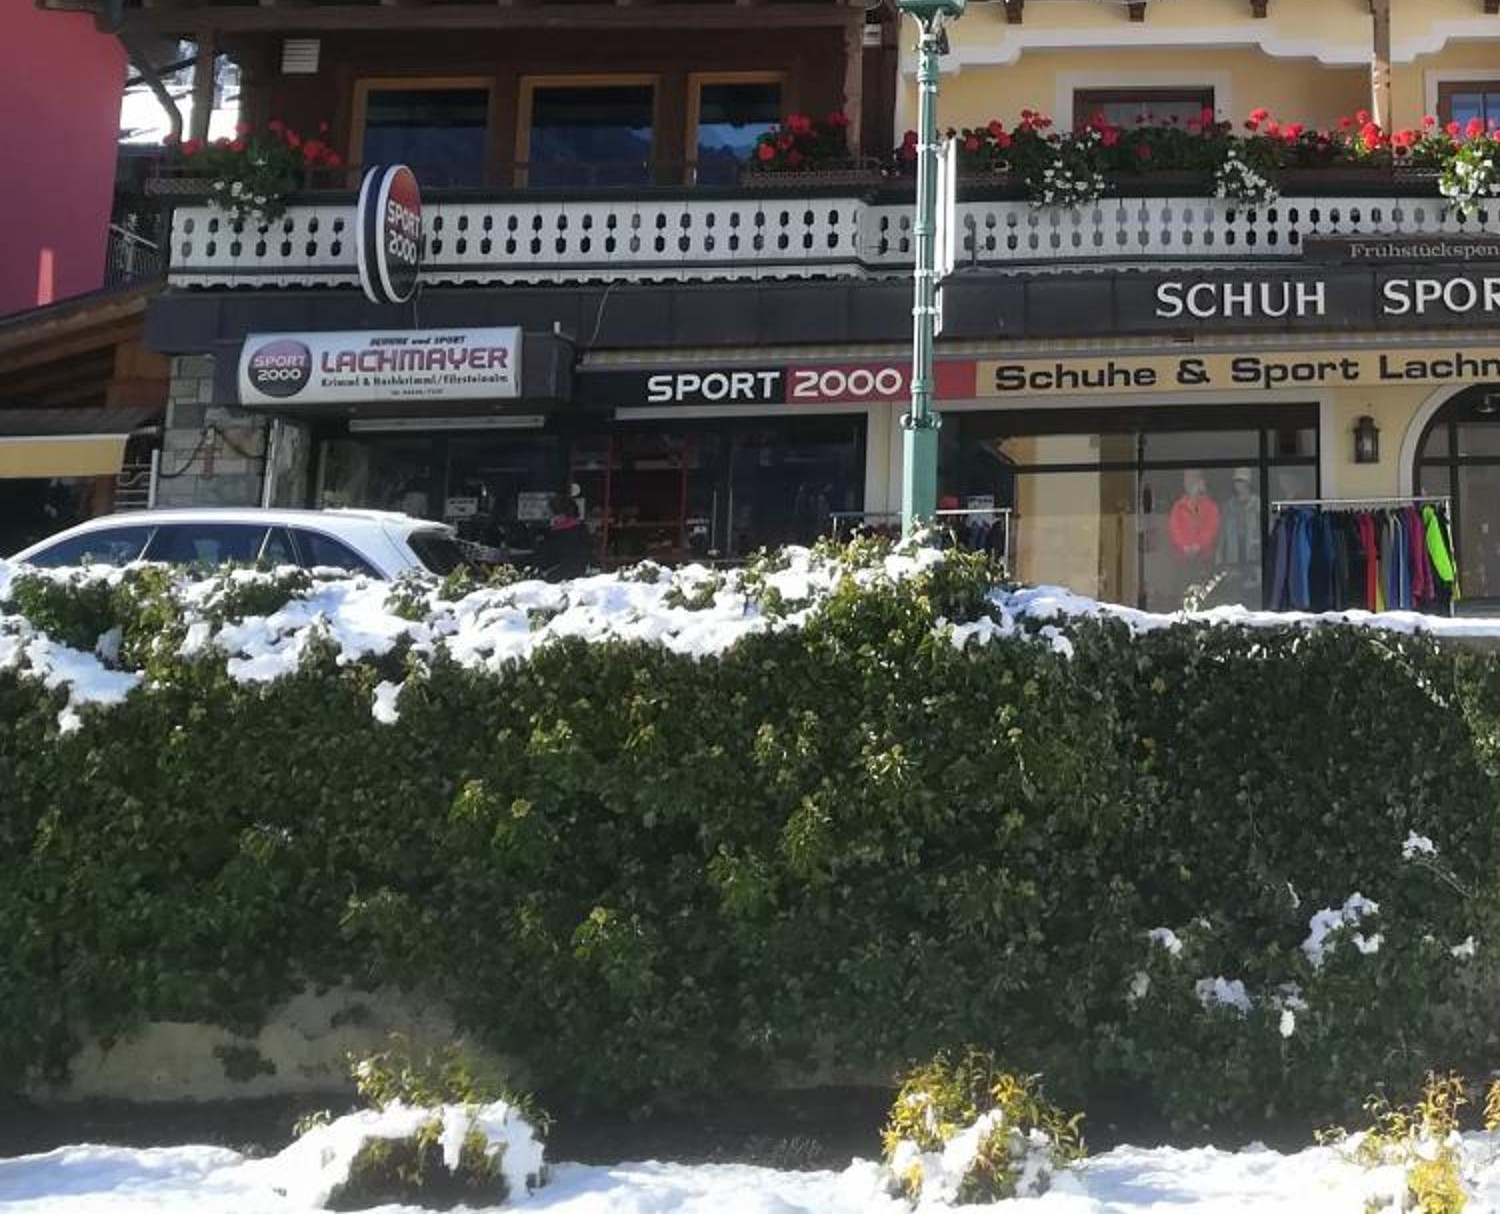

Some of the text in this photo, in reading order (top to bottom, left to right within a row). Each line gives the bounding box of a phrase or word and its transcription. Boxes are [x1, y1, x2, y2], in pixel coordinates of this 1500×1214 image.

[388, 198, 420, 241] SPORT
[389, 229, 417, 265] 2000
[1155, 280, 1326, 318] SCHUH
[254, 354, 305, 369] SPORT
[257, 368, 301, 382] 2000
[321, 347, 508, 374] LACHMAYER
[994, 359, 1157, 391] Schuhe
[1176, 358, 1211, 385] &
[1230, 356, 1360, 389] Sport
[647, 367, 902, 403] SPORT 2000
